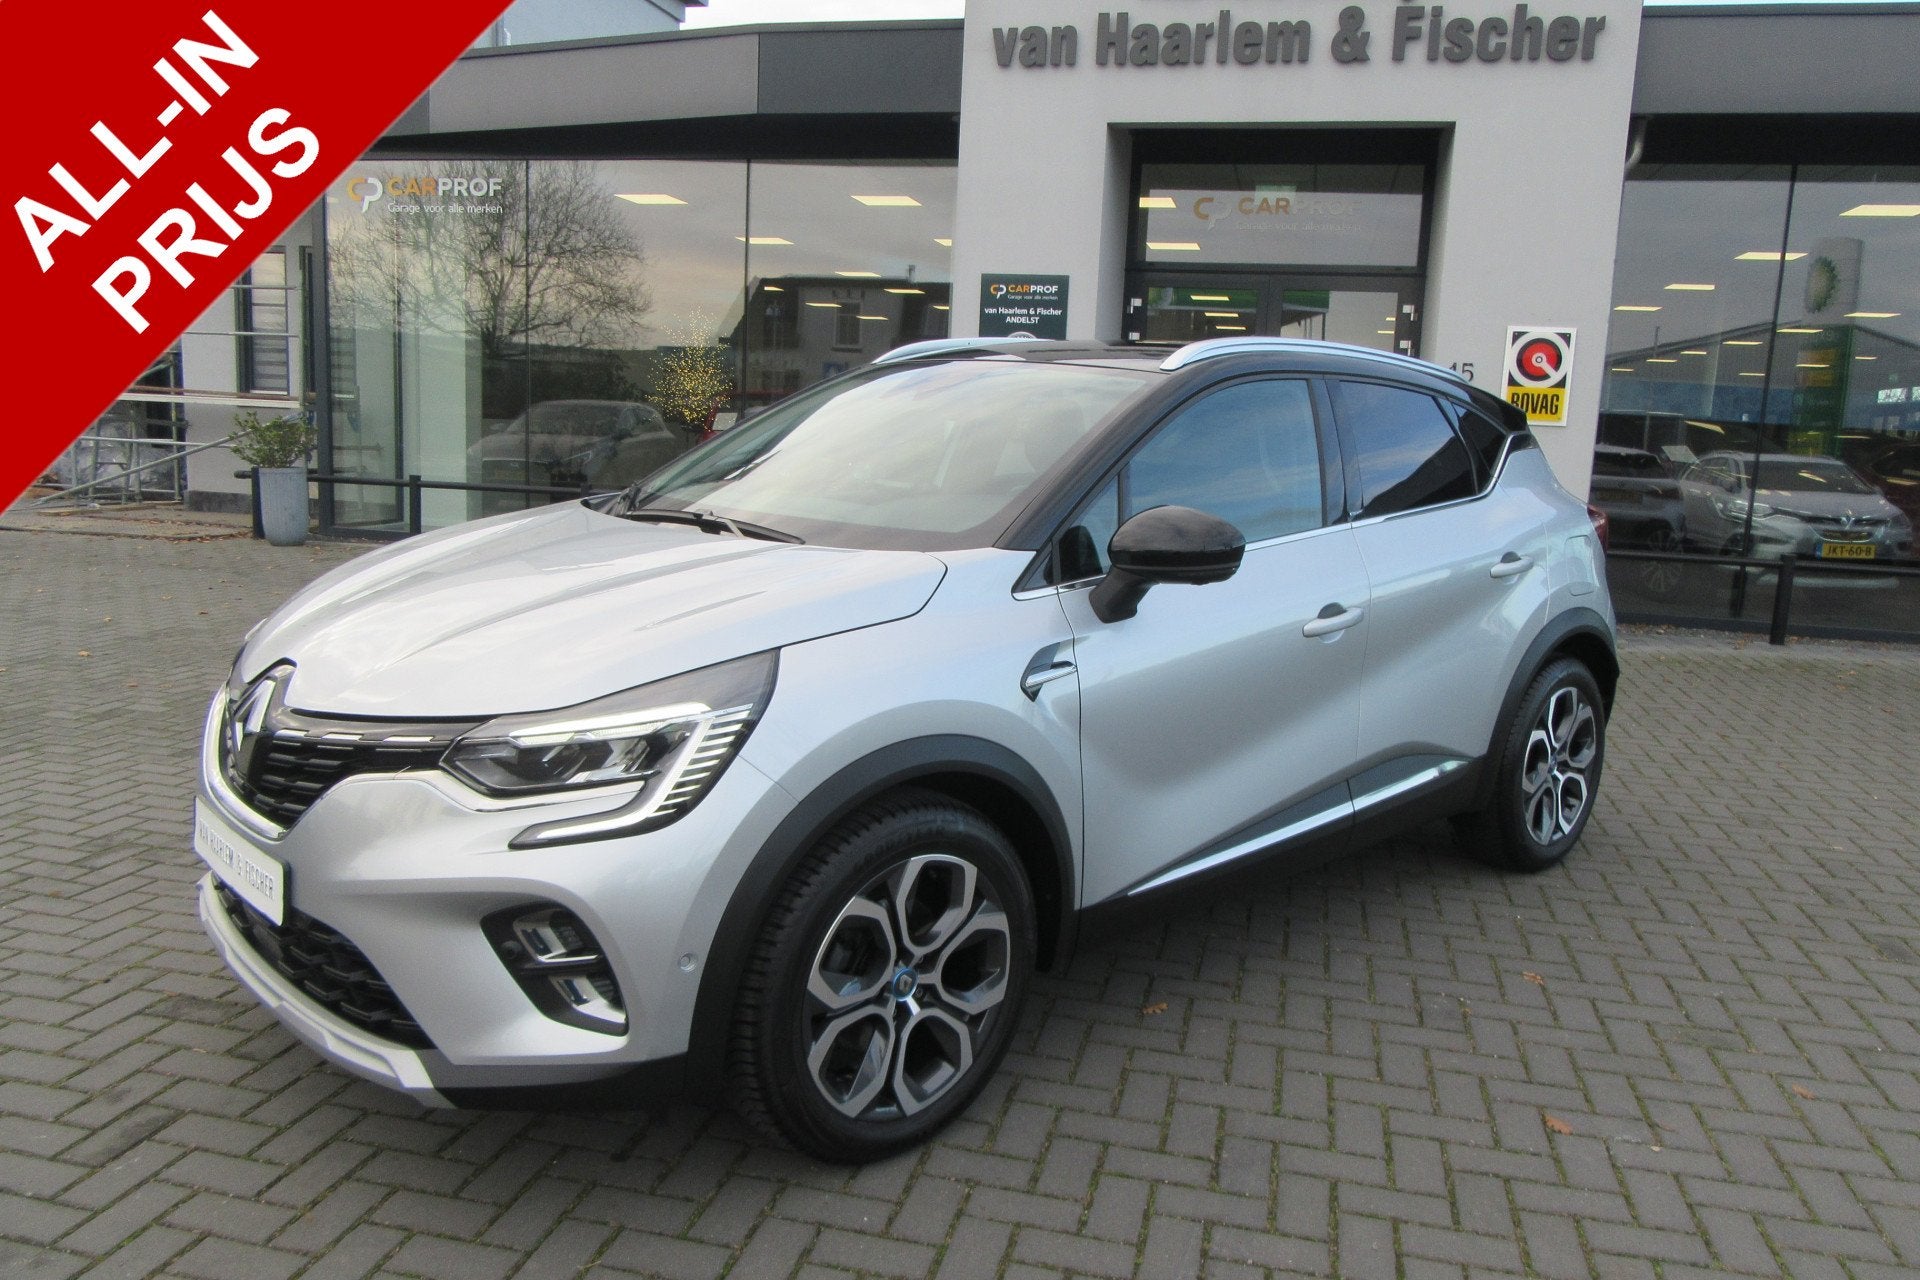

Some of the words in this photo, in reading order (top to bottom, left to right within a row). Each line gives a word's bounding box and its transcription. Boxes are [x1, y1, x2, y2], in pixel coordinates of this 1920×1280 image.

[992, 25, 1078, 67] van
[1096, 9, 1311, 67] Haarlem
[1331, 5, 1371, 63] &
[1392, 4, 1607, 64] Fischer
[386, 177, 503, 197] CARPROF
[387, 203, 421, 215] Garage
[449, 203, 464, 213] alle
[467, 203, 503, 213] merken
[1008, 284, 1059, 294] CARPROF
[998, 306, 1028, 315] Haarlem
[1029, 307, 1036, 315] &
[1036, 307, 1062, 316] Fischer
[1005, 316, 1040, 324] ANDELST
[1511, 392, 1560, 415] BOVAG
